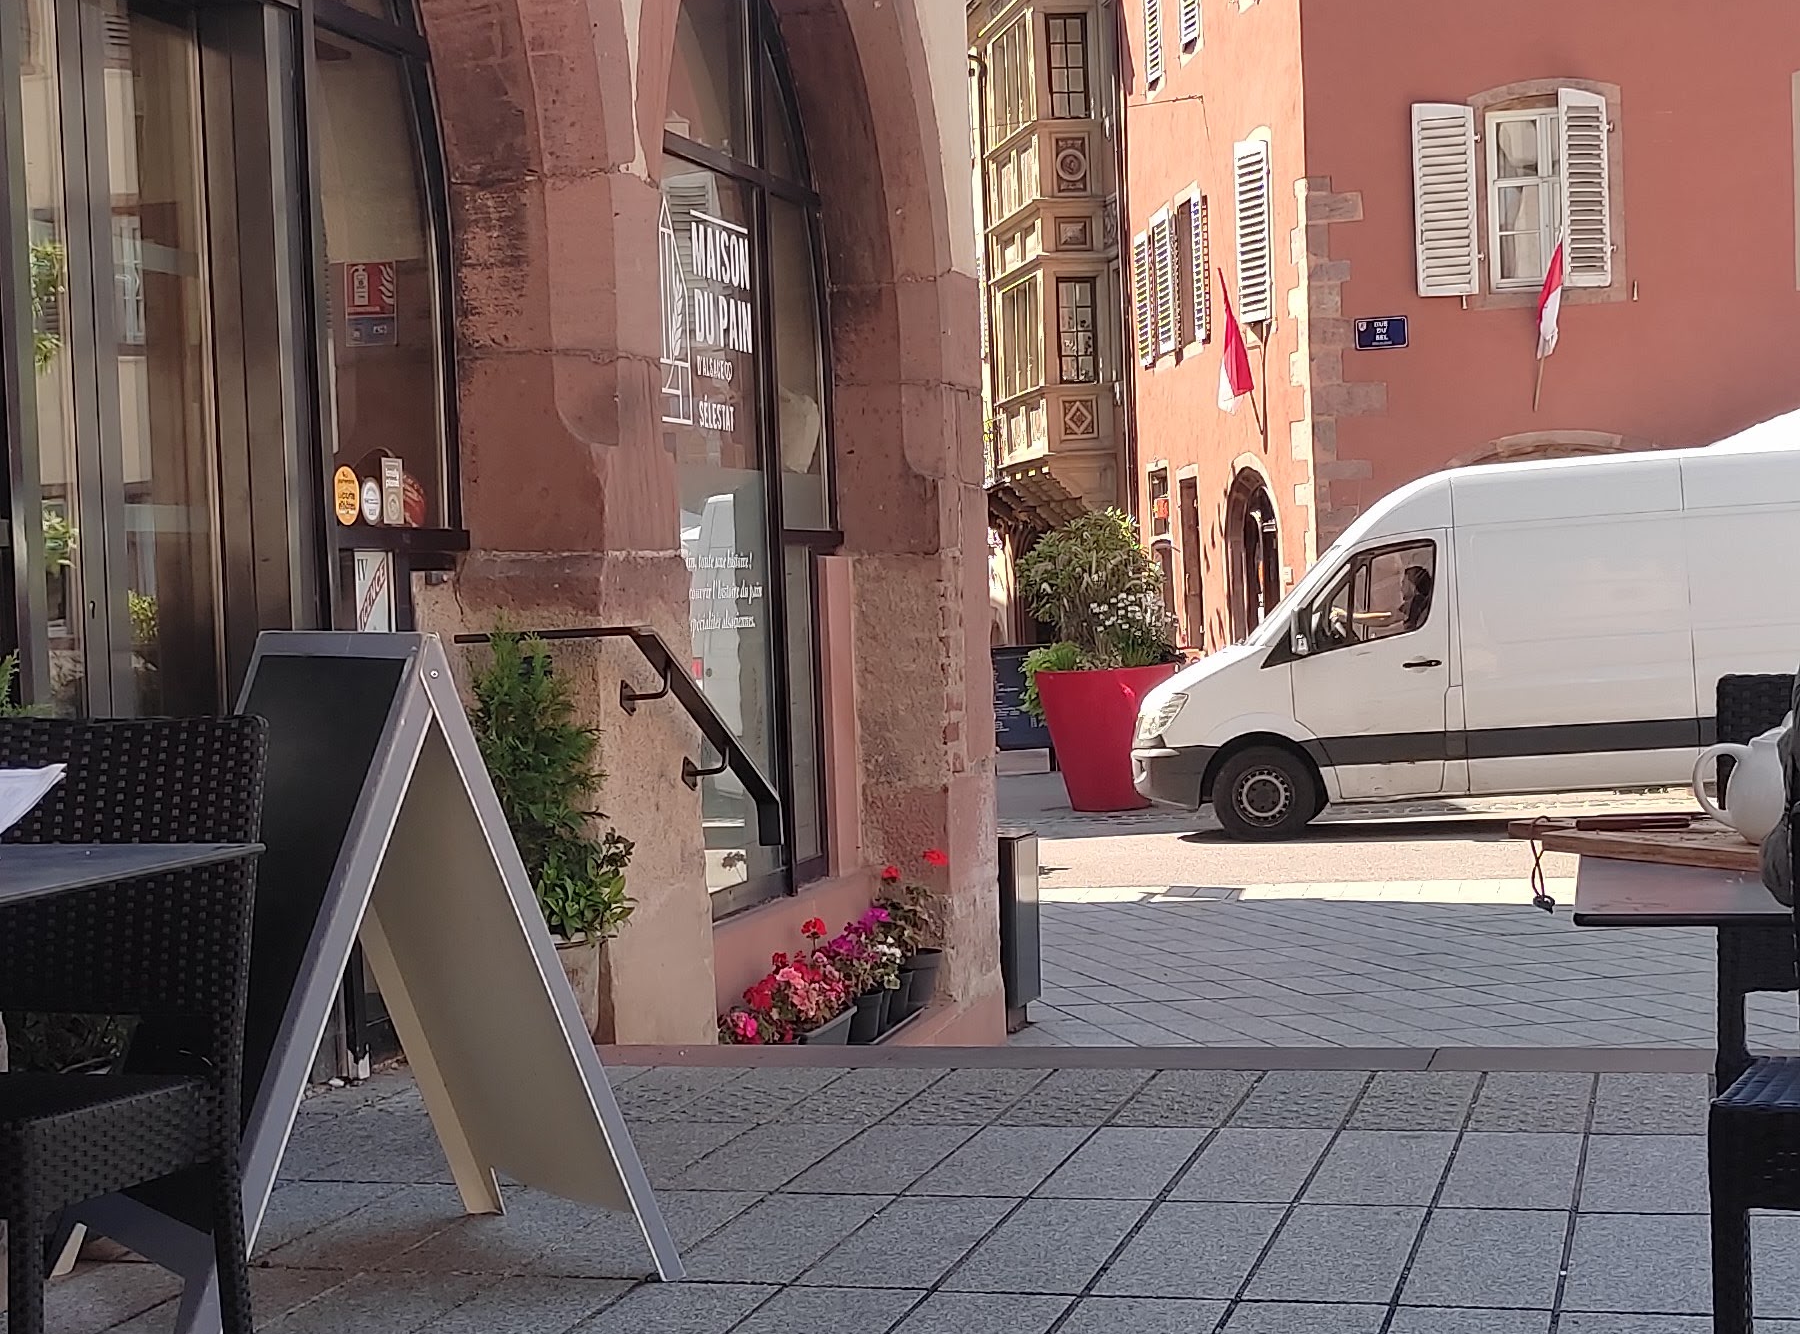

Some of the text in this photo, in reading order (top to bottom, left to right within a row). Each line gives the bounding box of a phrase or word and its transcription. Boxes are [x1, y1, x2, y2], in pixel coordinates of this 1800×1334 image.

[691, 221, 750, 290] MAISON
[694, 289, 752, 353] DU PAIN
[696, 355, 725, 380] D'ALSACE
[699, 394, 734, 432] SÉLESTAT
[357, 558, 368, 581] IV
[361, 562, 386, 631] ICENCE
